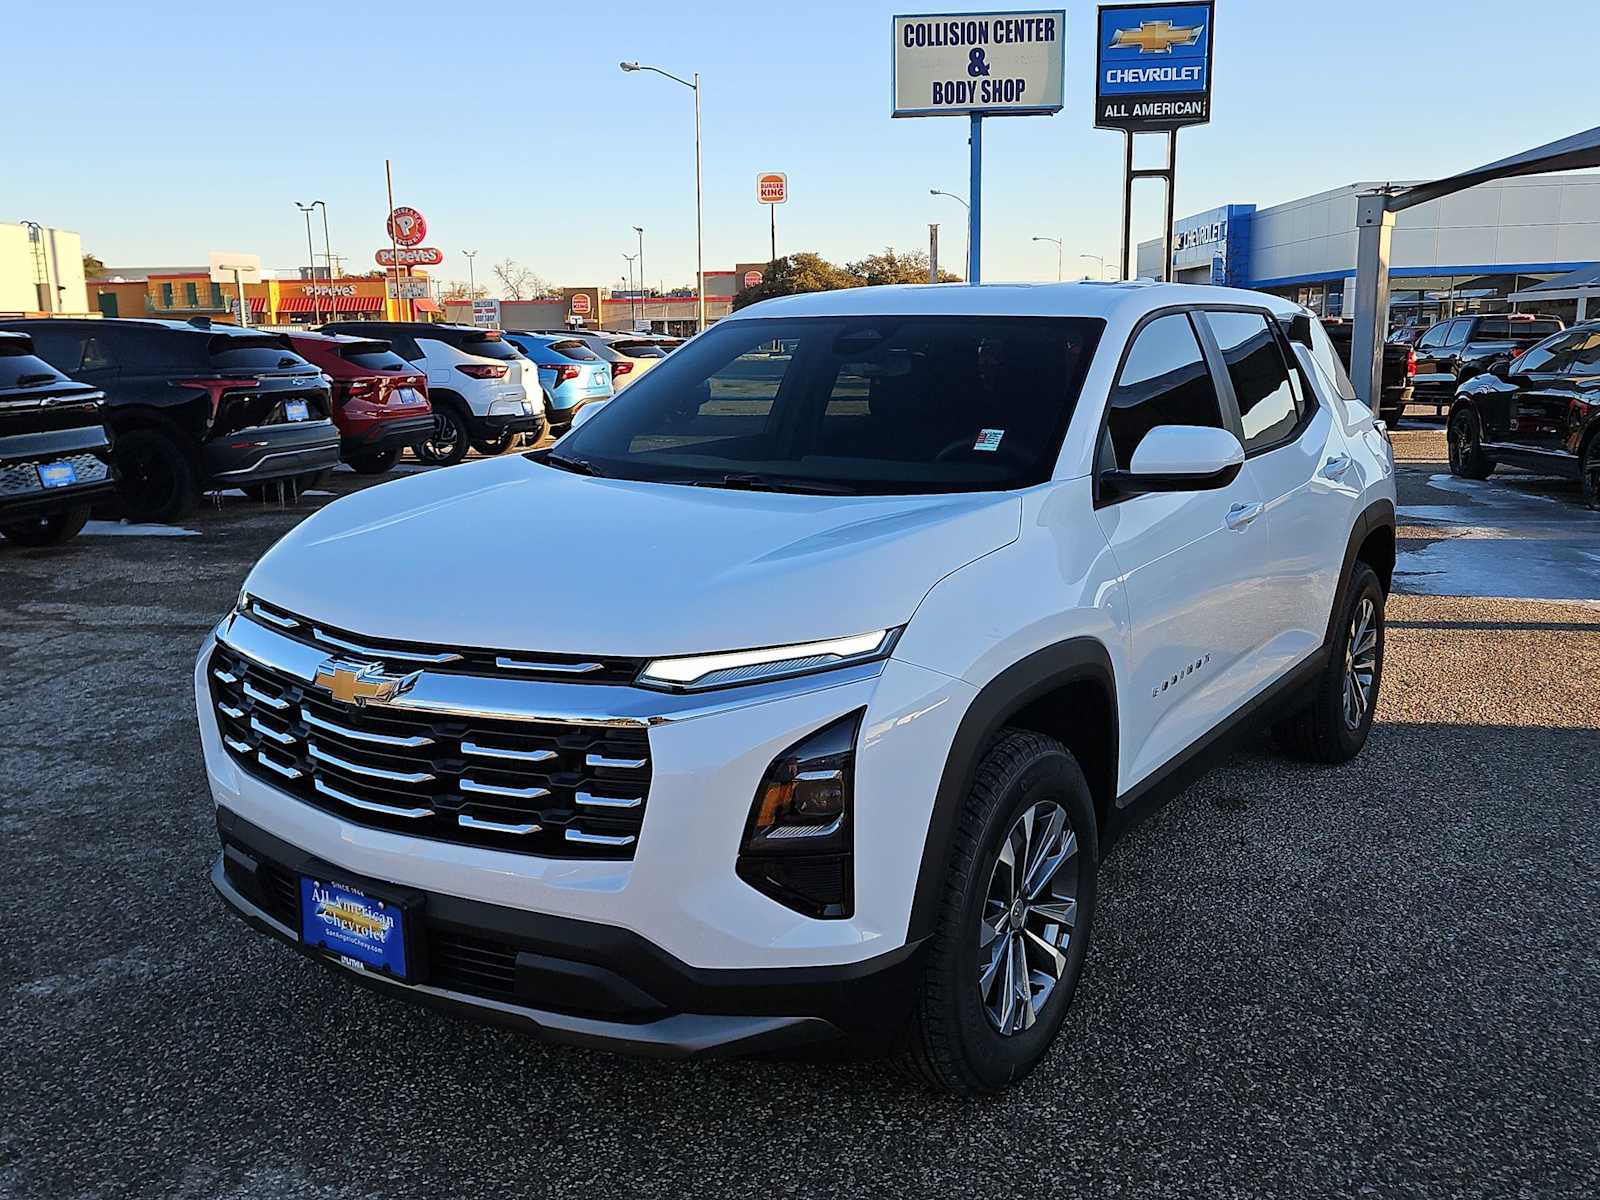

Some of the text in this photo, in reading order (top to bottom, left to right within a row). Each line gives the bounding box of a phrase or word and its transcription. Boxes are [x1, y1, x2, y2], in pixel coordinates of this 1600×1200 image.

[903, 18, 1056, 48] COLLISION CENTER
[967, 47, 990, 77] &
[1106, 66, 1202, 84] CHEVROLET
[932, 79, 1026, 105] BODY SHOP
[1104, 101, 1202, 118] ALL AMERICAN
[760, 188, 784, 197] KING
[1183, 222, 1225, 249] CHEVROLET
[311, 888, 395, 929] All American
[322, 910, 386, 943] Chevrolet
